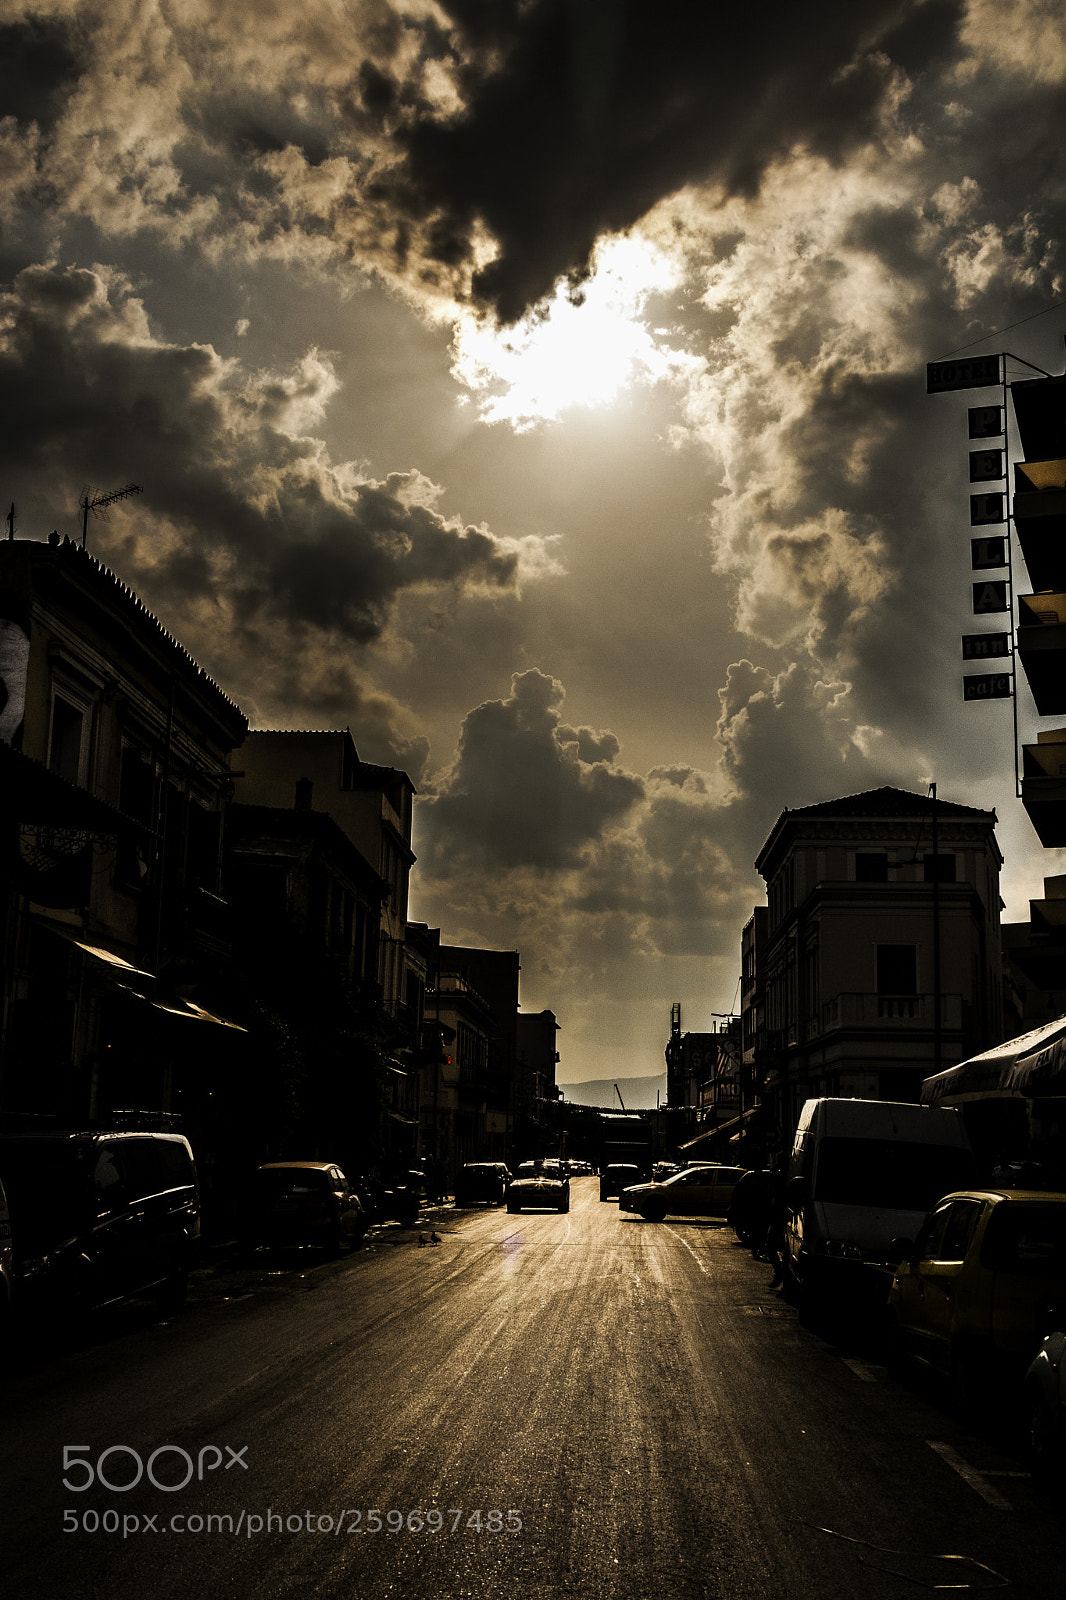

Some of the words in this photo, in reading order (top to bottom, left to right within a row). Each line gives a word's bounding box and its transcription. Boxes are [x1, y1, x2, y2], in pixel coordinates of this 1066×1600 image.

[927, 361, 996, 386] HOTEL
[970, 407, 1003, 611] PELLA
[964, 637, 1005, 656] inn
[966, 675, 1007, 697] cafe
